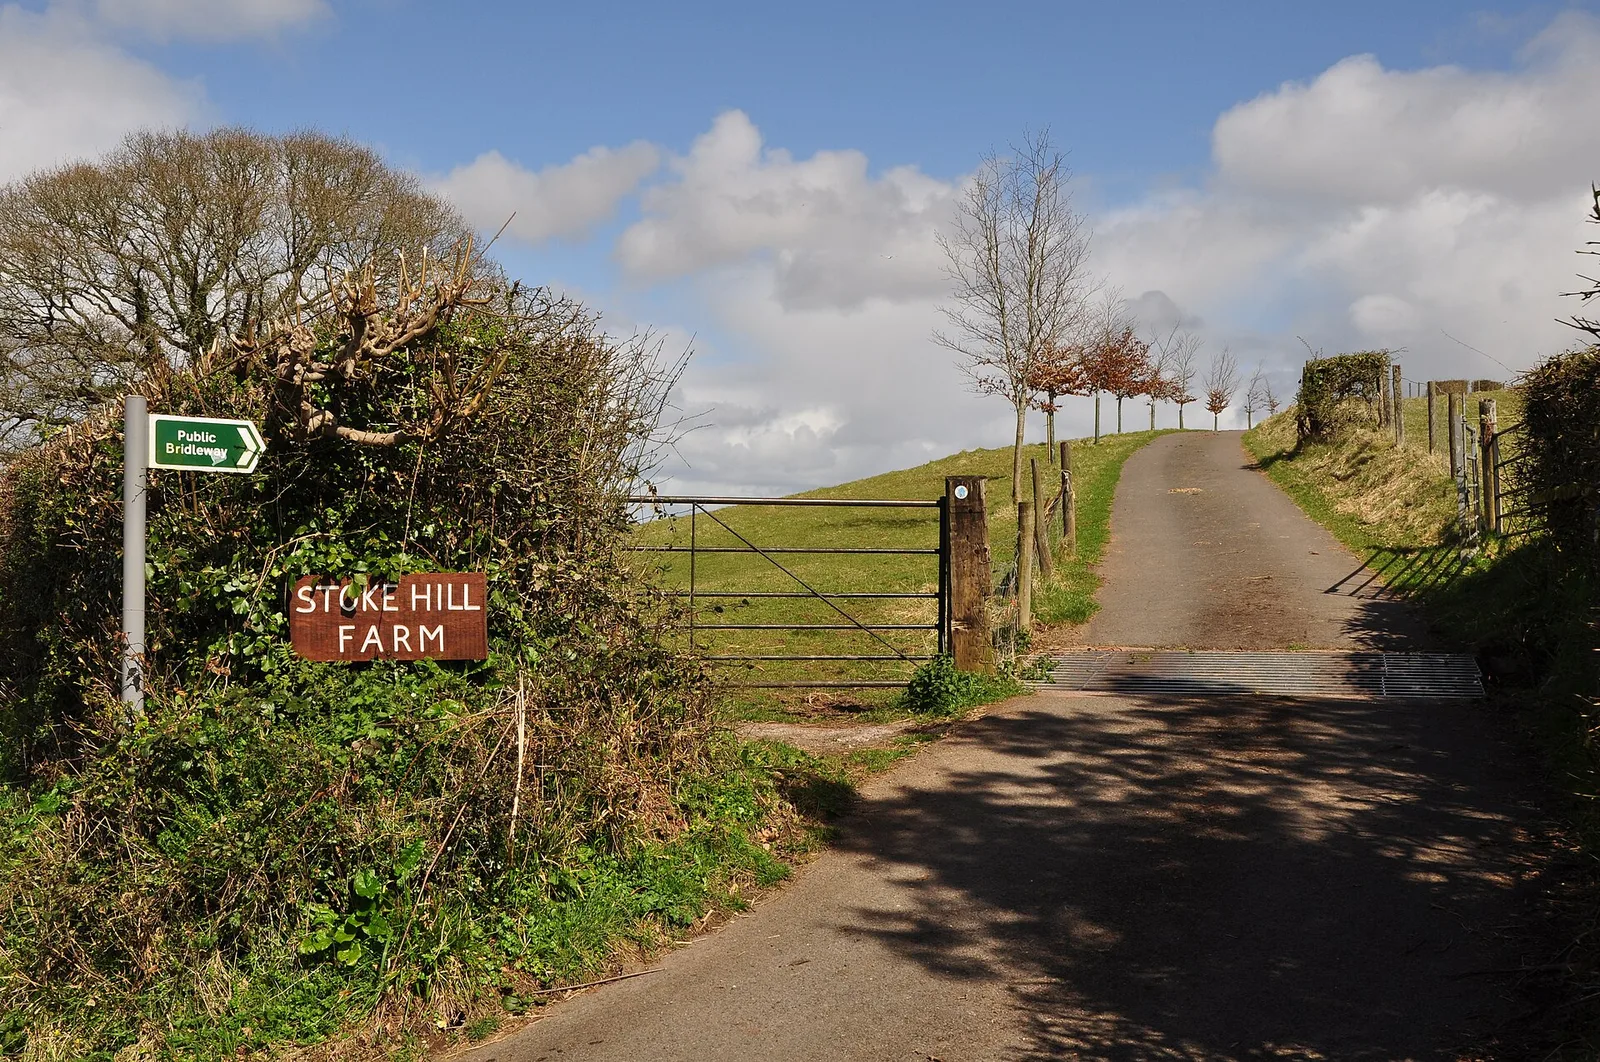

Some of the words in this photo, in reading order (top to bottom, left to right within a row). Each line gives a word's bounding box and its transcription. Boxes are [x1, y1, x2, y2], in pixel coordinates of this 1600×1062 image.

[177, 430, 217, 443] Public
[165, 442, 228, 458] Bridleway
[295, 583, 399, 614] STOKE
[411, 583, 481, 612] HILL
[338, 624, 444, 653] FARM
